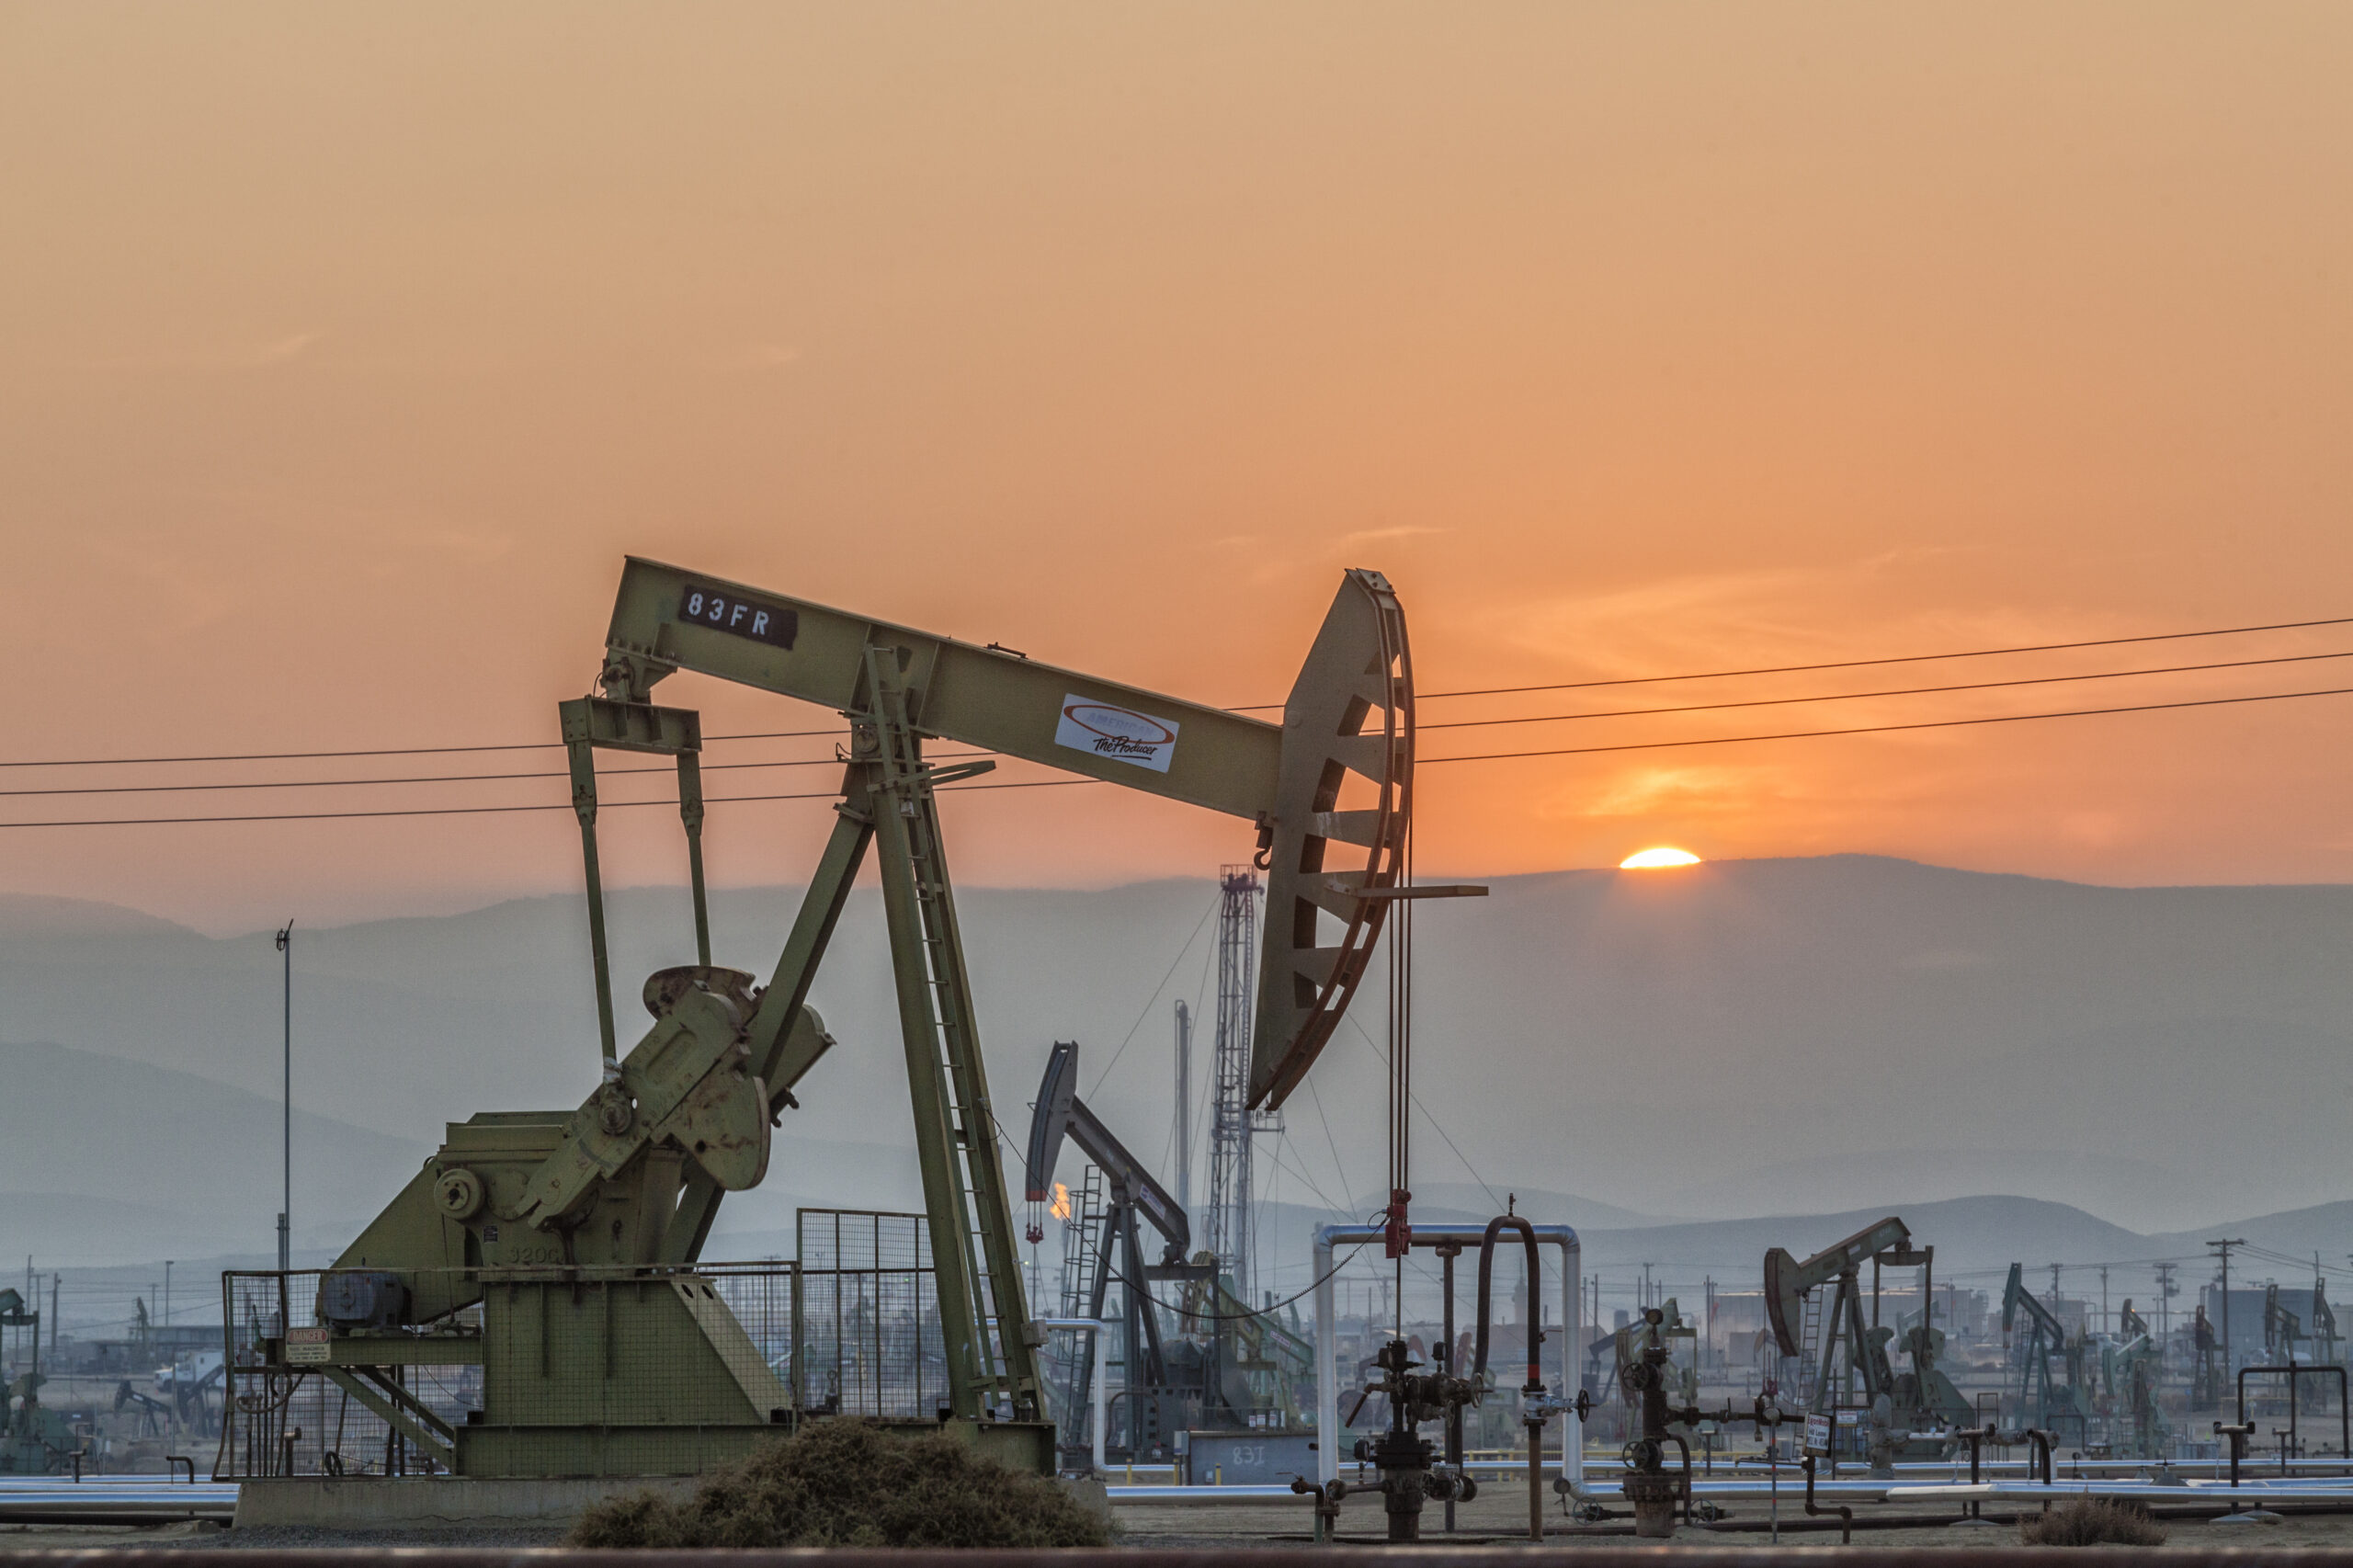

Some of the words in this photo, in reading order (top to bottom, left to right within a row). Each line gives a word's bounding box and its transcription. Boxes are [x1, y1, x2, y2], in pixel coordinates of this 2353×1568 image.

[688, 593, 769, 635] 83FR
[1112, 735, 1158, 756] Producer
[293, 1330, 323, 1342] DANGER
